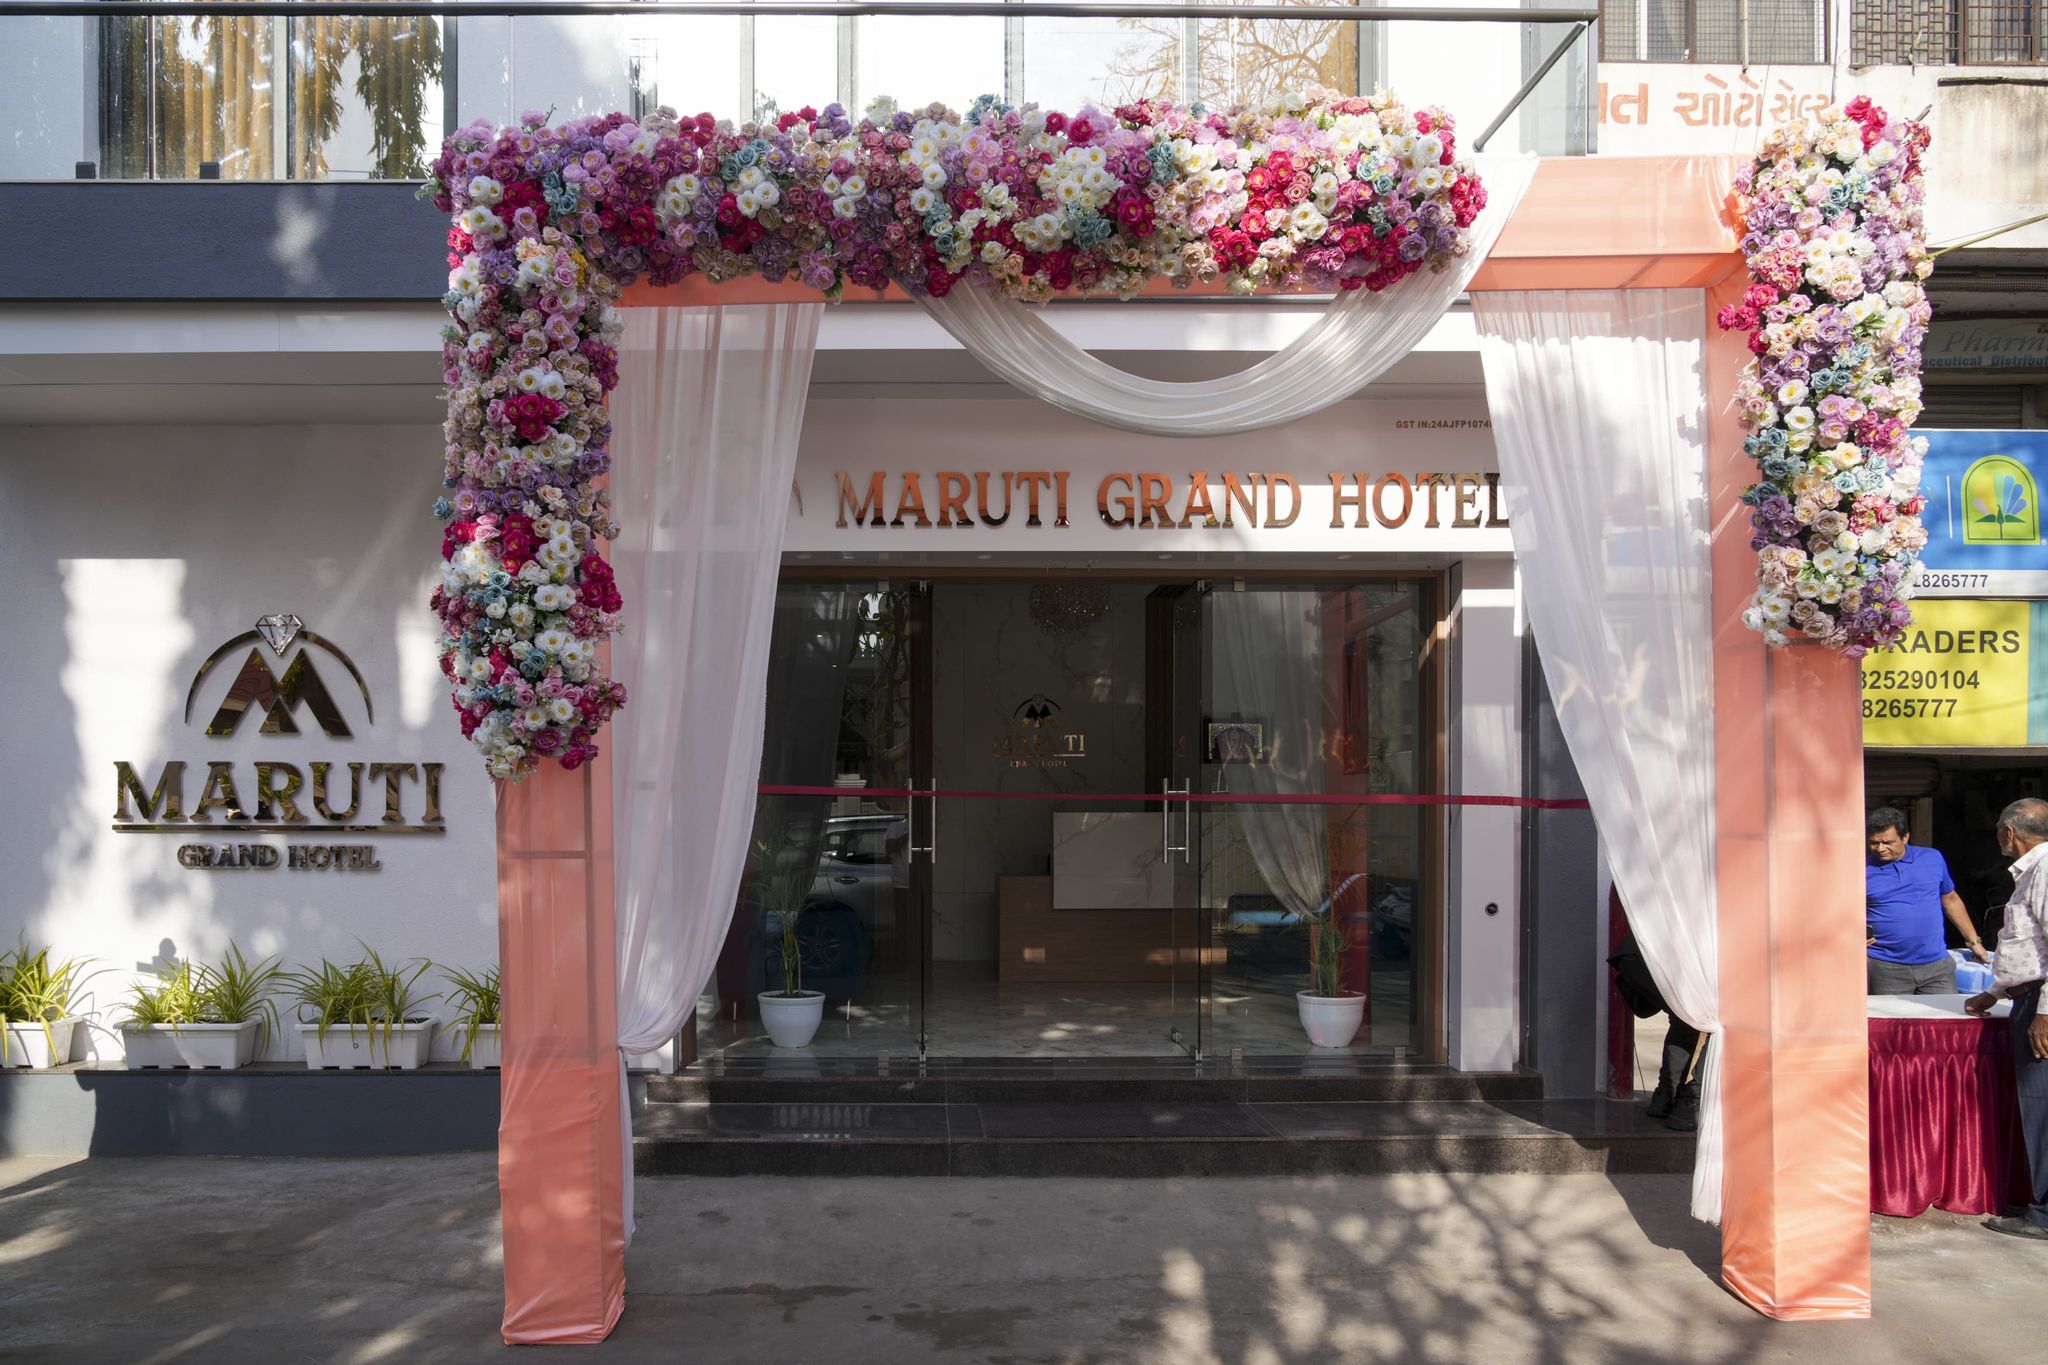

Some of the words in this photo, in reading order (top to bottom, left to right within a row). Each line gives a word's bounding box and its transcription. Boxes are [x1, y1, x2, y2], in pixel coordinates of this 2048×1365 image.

[1939, 328, 2048, 352] Pharm
[1922, 355, 1982, 367] aceutical
[1396, 420, 1415, 429] GST
[1418, 420, 1492, 429] IN:24AJFP1074
[835, 471, 1071, 530] MARUTI
[1097, 471, 1301, 530] GRAND
[1328, 470, 1510, 530] HOTEL
[113, 761, 446, 823] MARUTI
[177, 844, 281, 870] GRAND
[287, 844, 382, 870] HOTEL
